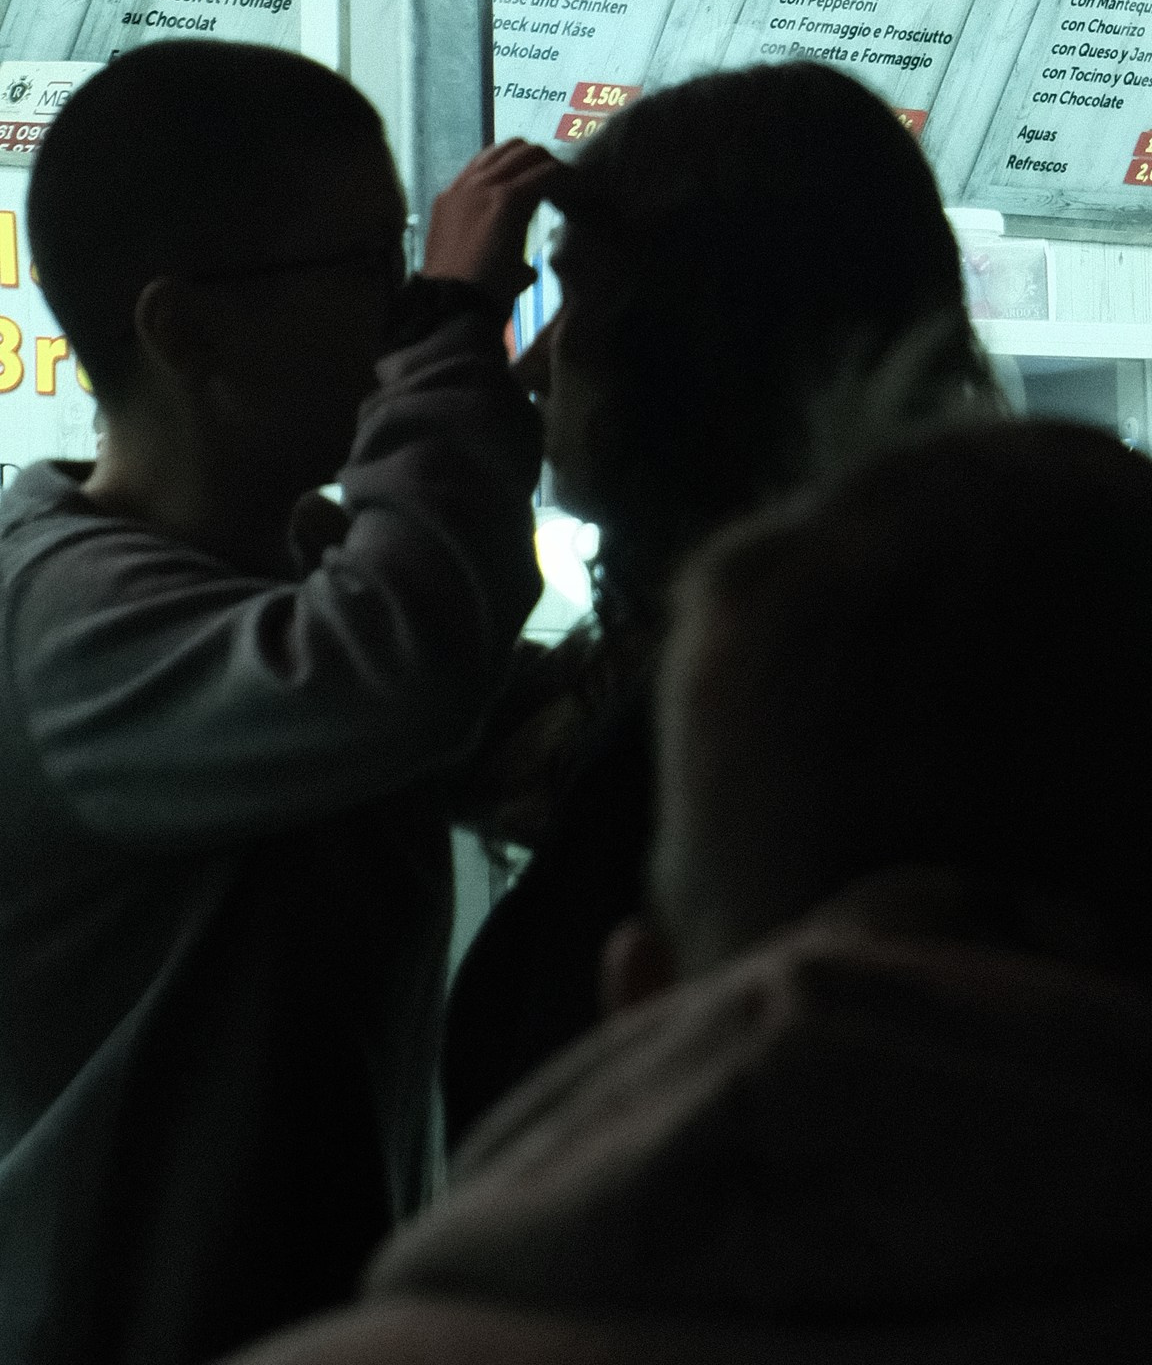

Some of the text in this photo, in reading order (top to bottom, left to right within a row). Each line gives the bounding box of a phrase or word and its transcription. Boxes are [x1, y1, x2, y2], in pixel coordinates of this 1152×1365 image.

[121, 10, 218, 31] au Chocolat
[493, 14, 596, 39] peck und Käse
[769, 16, 954, 45] con Formaggio e Prosciutto
[1060, 18, 1146, 38] con Chourizo
[760, 41, 934, 71] con Pancetta e Formaggio
[1051, 42, 1076, 57] con
[1078, 42, 1119, 61] Queso
[1117, 48, 1129, 65] y
[1042, 66, 1067, 81] con
[1069, 66, 1112, 85] Tocino
[1110, 73, 1122, 89] y
[503, 82, 568, 103] Flaschen
[582, 85, 628, 107] 1,50€
[1032, 90, 1125, 110] con Chocolate
[1016, 125, 1058, 144] Aguas
[1005, 154, 1069, 174] Refrescos
